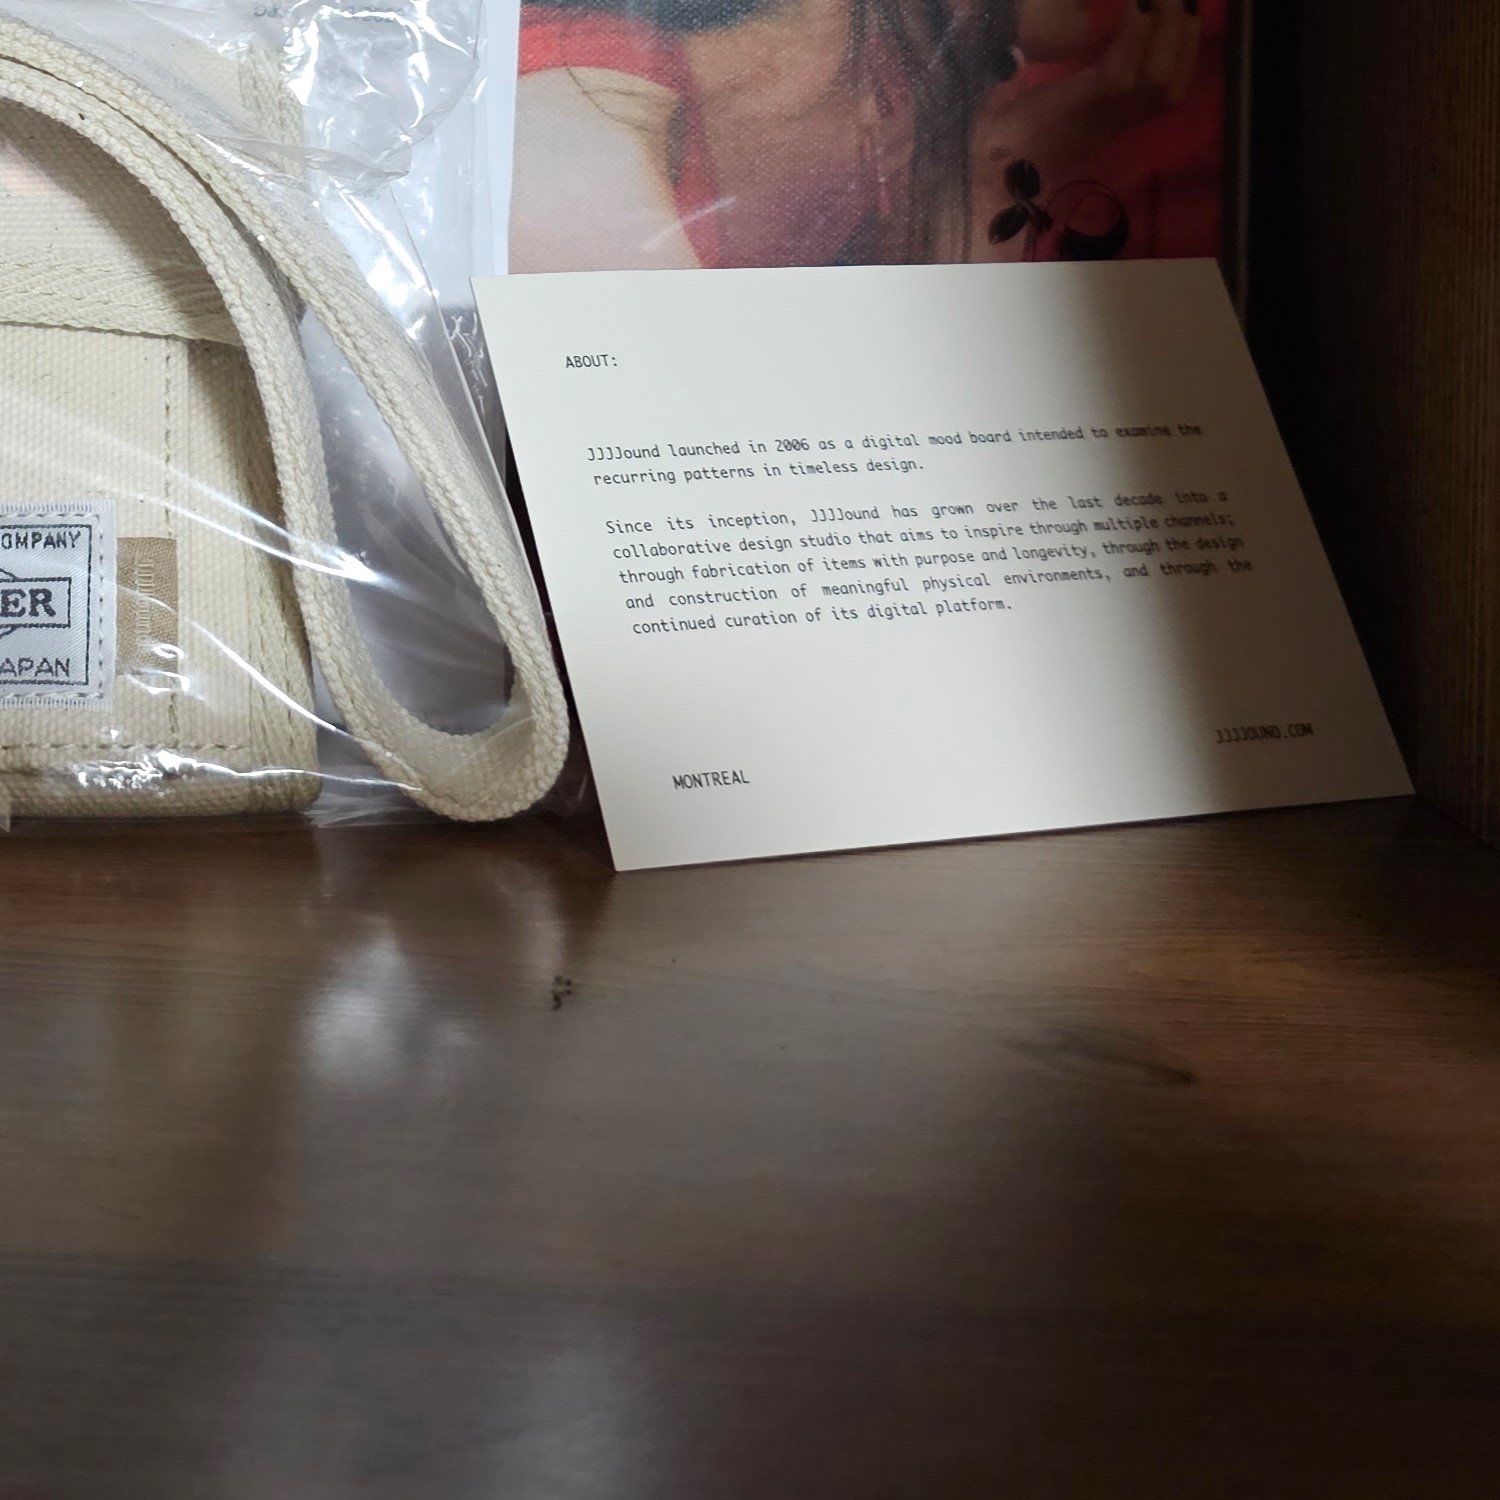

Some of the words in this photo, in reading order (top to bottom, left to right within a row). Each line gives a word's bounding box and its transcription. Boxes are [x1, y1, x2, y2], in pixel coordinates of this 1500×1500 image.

[566, 354, 617, 368] ABOUT:
[588, 445, 660, 460] JJJJound
[668, 441, 740, 457] launched
[749, 440, 767, 454] in
[774, 438, 809, 452] 2006
[818, 440, 835, 450] as
[844, 438, 853, 449] a
[862, 434, 920, 451] digital
[929, 432, 962, 445] mood
[969, 430, 1011, 444] board
[1018, 427, 1084, 442] intended
[1091, 425, 1108, 438] to
[1177, 423, 1202, 436] the
[594, 468, 676, 485] recurring
[684, 465, 754, 483] patterns
[763, 463, 781, 477] in
[789, 461, 858, 475] timeless
[867, 457, 923, 473] design.
[606, 520, 652, 534] Since
[667, 517, 693, 531] its
[709, 512, 796, 529] inception,
[811, 506, 879, 522] JJJJound
[892, 504, 917, 518] has
[931, 502, 973, 519] grown
[986, 501, 1018, 513] over
[1032, 497, 1057, 511] the
[1070, 496, 1103, 509] last
[1174, 491, 1208, 504] into
[613, 540, 731, 559] collaborative
[739, 536, 792, 553] design
[800, 532, 851, 547] studio
[858, 531, 892, 544] that
[900, 528, 933, 542] aims
[941, 527, 958, 540] to
[965, 524, 1023, 541] inspire
[1029, 521, 1088, 537] through
[1094, 516, 1158, 532] multiple
[619, 567, 684, 584] through
[693, 561, 790, 579] fabrication
[798, 558, 814, 572] of
[823, 557, 866, 571] items
[872, 554, 908, 567] with
[915, 552, 974, 567] purpose
[982, 548, 1007, 562] and
[1015, 544, 1096, 561] longevity,
[1102, 540, 1159, 556] through
[1165, 538, 1189, 551] the
[1195, 535, 1244, 552] design
[626, 594, 654, 609] and
[669, 586, 777, 606] construction
[791, 584, 808, 598] of
[822, 578, 909, 596] meaningful
[922, 573, 990, 592] physical
[1004, 567, 1111, 585] environments,
[1123, 563, 1148, 577] and
[1160, 560, 1216, 577] through
[1227, 559, 1252, 573] the
[633, 615, 716, 634] continued
[725, 609, 797, 628] curation
[805, 607, 822, 622] of
[831, 605, 858, 620] its
[867, 602, 927, 620] digital
[936, 597, 1012, 616] platform.
[672, 769, 750, 790] MONTREAL
